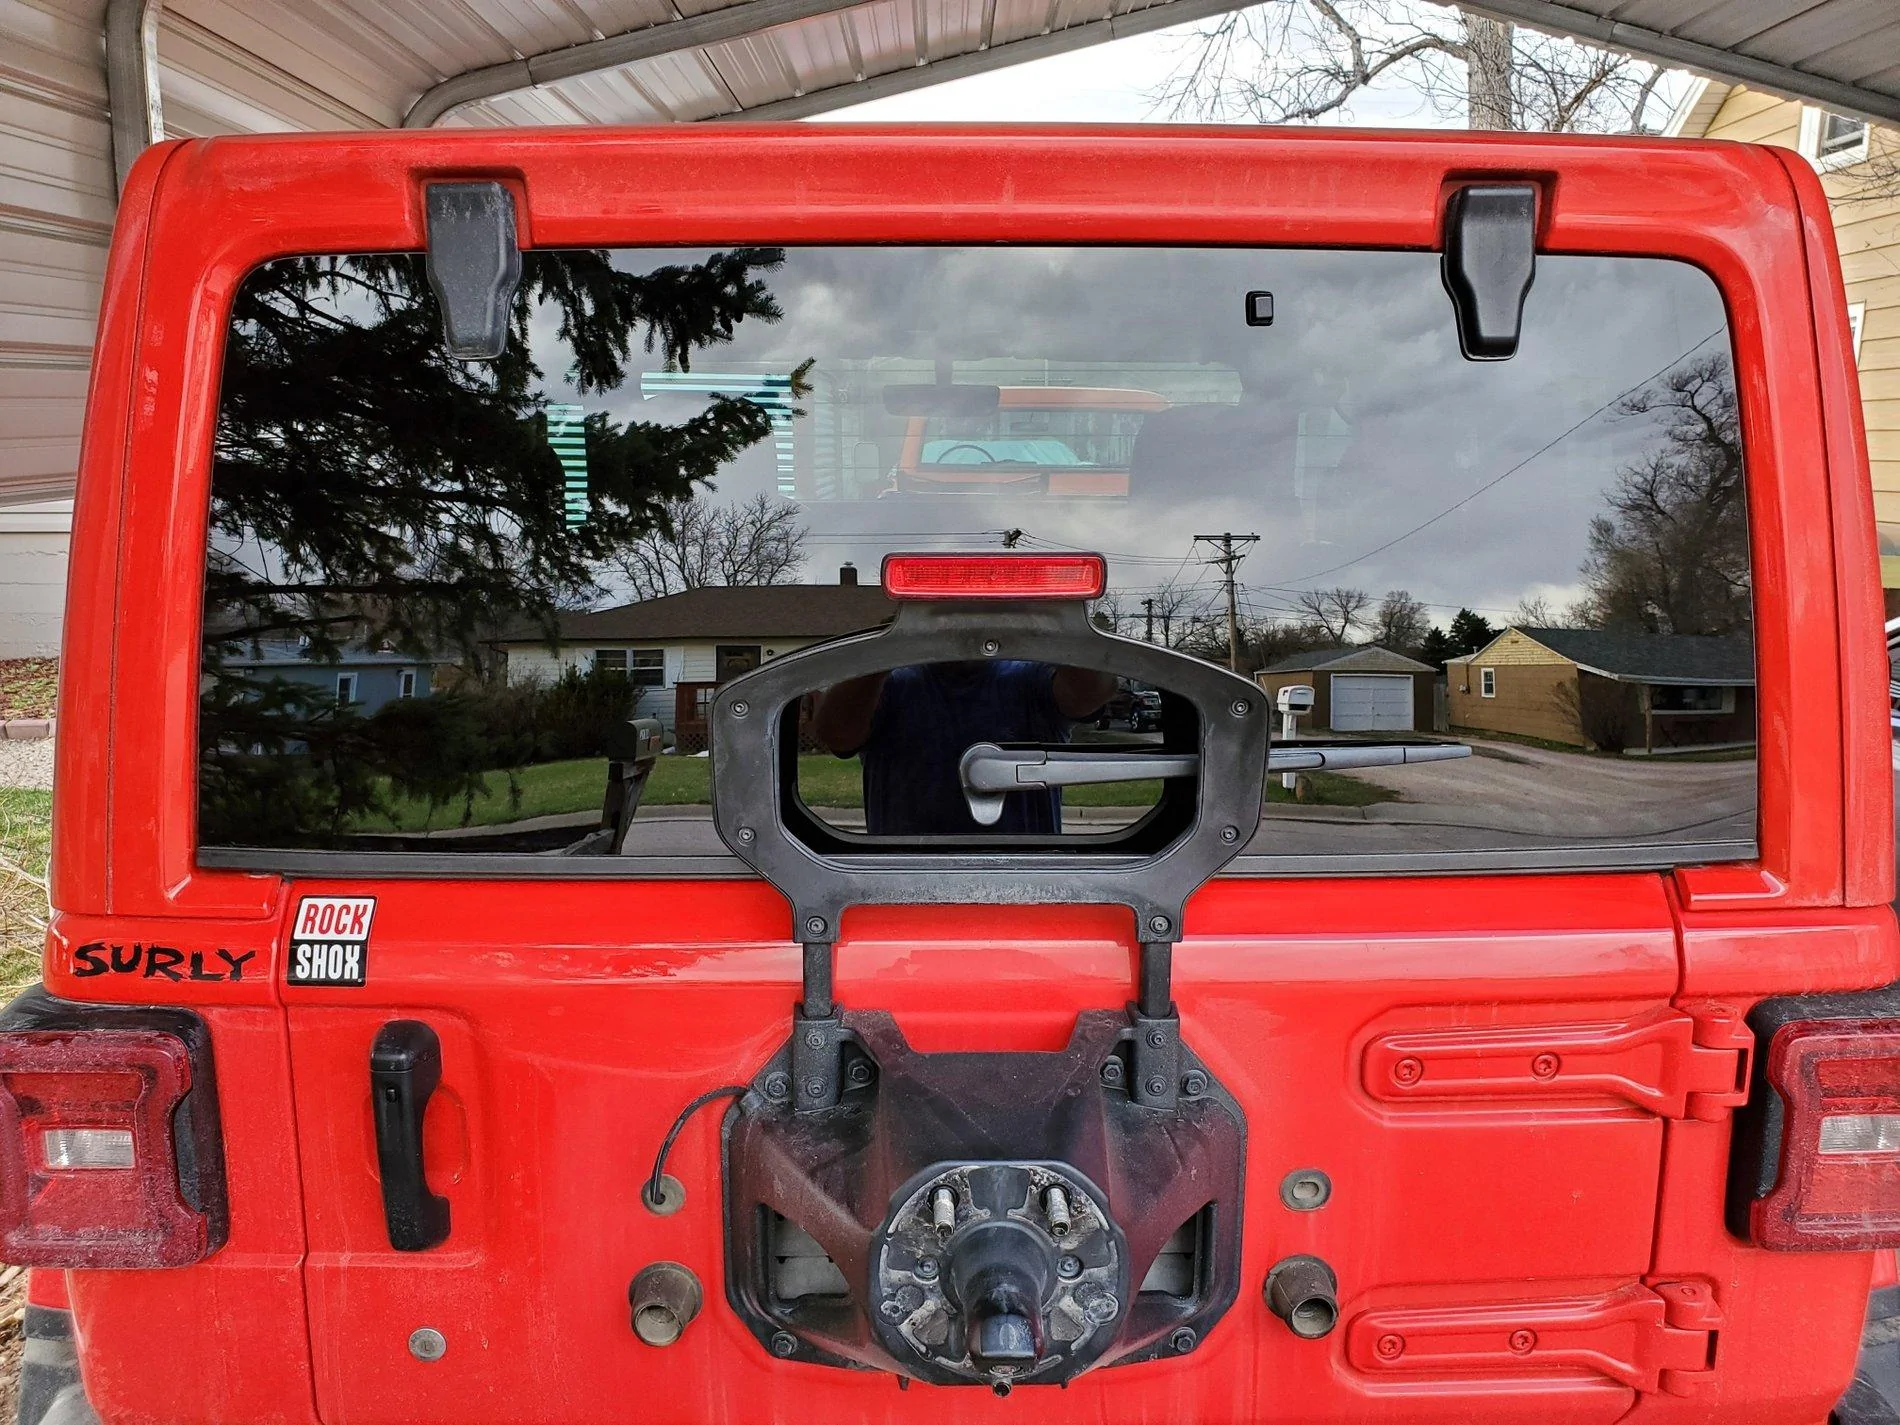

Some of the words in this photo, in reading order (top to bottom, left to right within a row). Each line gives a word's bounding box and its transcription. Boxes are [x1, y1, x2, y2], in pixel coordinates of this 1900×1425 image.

[301, 903, 368, 935] ROCK
[73, 942, 256, 983] SURLY
[295, 944, 361, 980] SHOX
